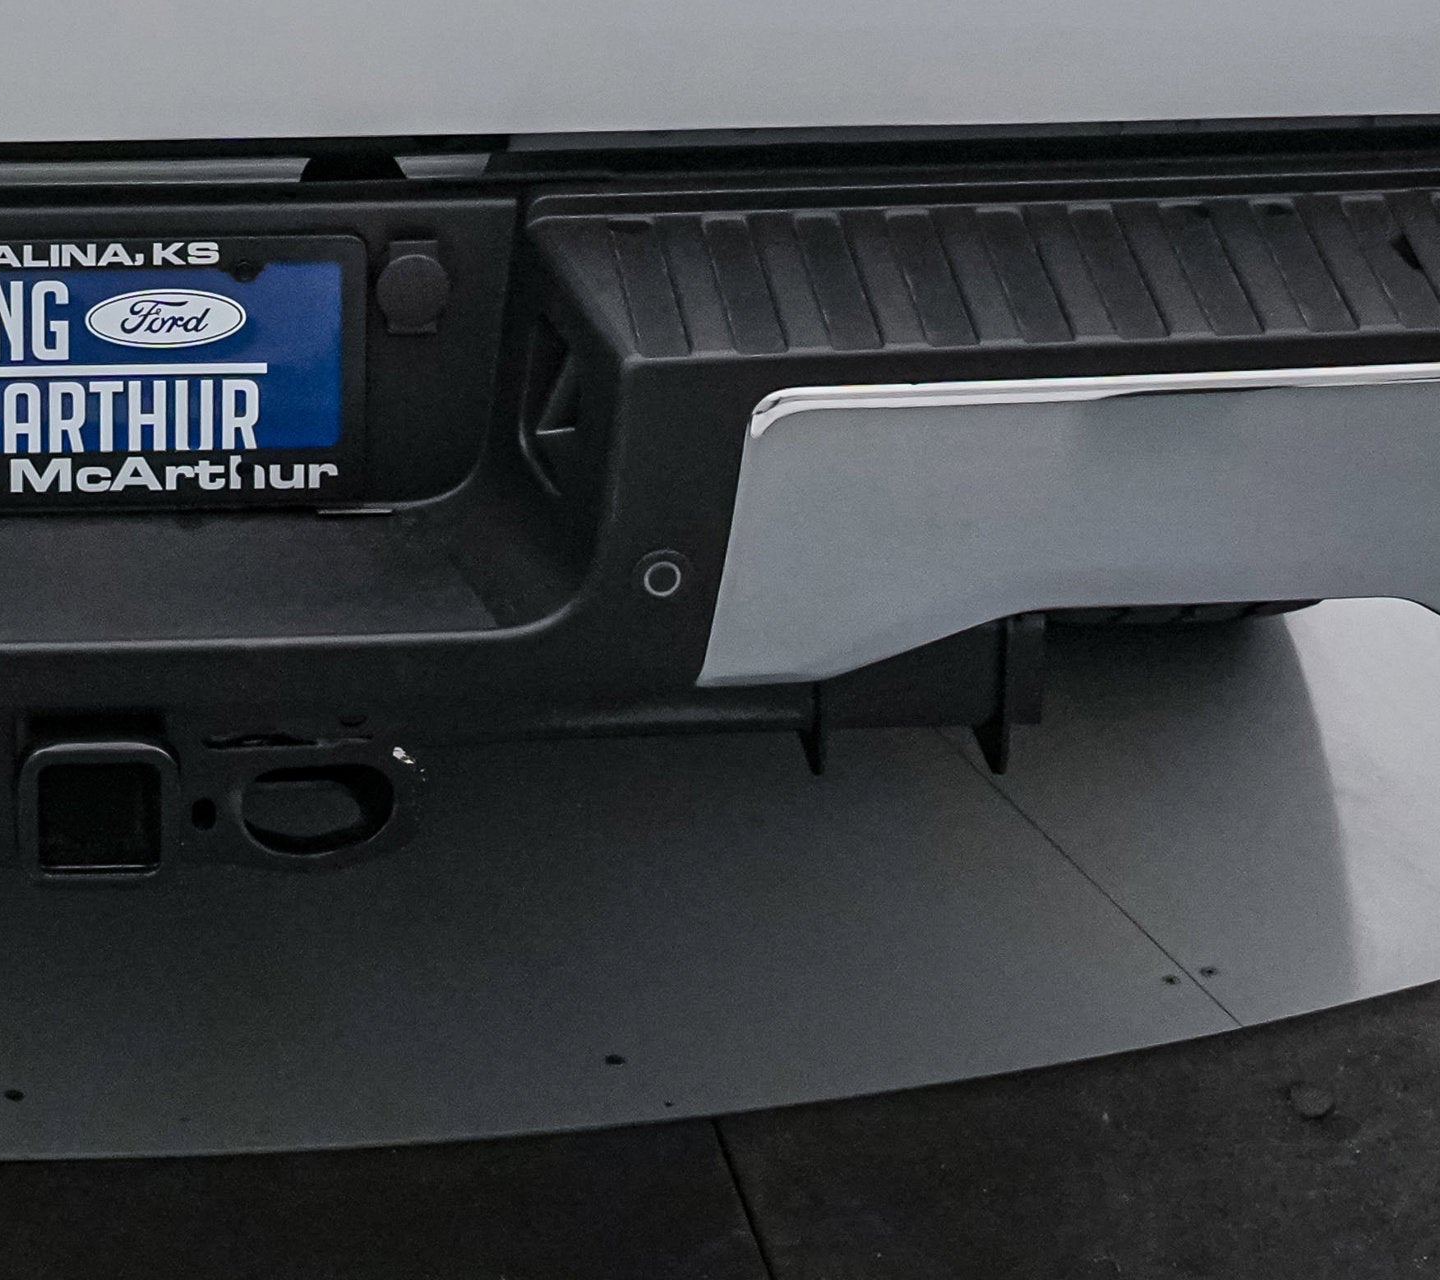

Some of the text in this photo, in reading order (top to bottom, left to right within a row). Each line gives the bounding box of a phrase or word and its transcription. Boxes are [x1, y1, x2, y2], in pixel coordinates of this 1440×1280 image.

[153, 241, 219, 266] KS
[120, 300, 211, 334] Ford
[10, 455, 339, 493] McArthur
